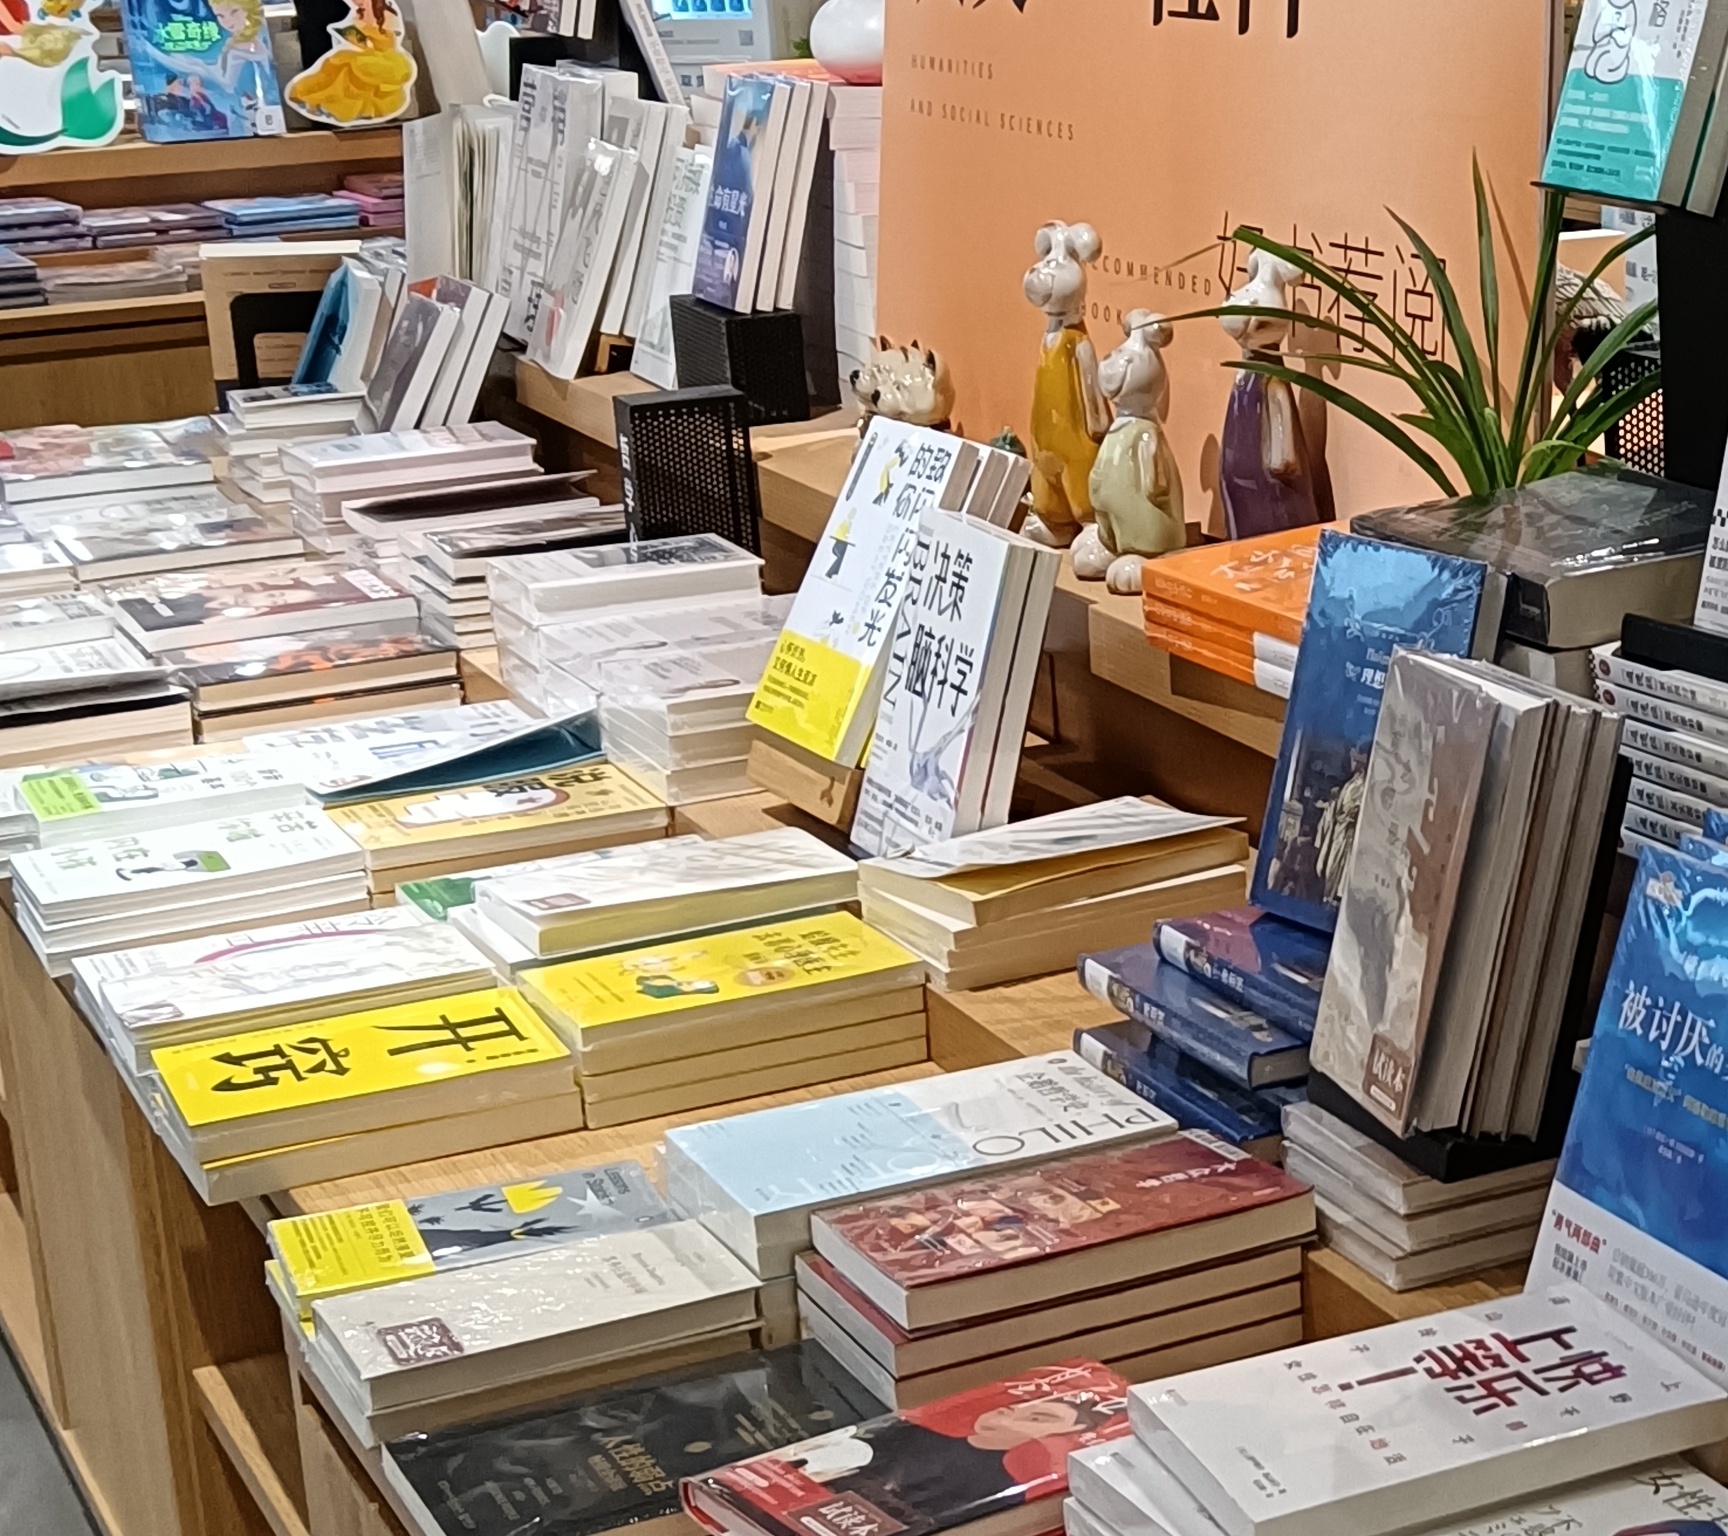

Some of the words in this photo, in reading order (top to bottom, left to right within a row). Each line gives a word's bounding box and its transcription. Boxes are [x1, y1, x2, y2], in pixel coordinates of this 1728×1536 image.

[911, 53, 994, 81] HUMANITIES
[910, 98, 934, 119] AND
[942, 102, 991, 128] SOCIAL
[1000, 112, 1075, 142] SCIENCES
[923, 540, 973, 622] 决策
[904, 622, 974, 718] 脑科学
[209, 1006, 530, 1094] 开窍
[971, 1107, 1160, 1157] PHILO
[1326, 1311, 1599, 1409] 上等!
[1438, 1344, 1643, 1418] 快乐
